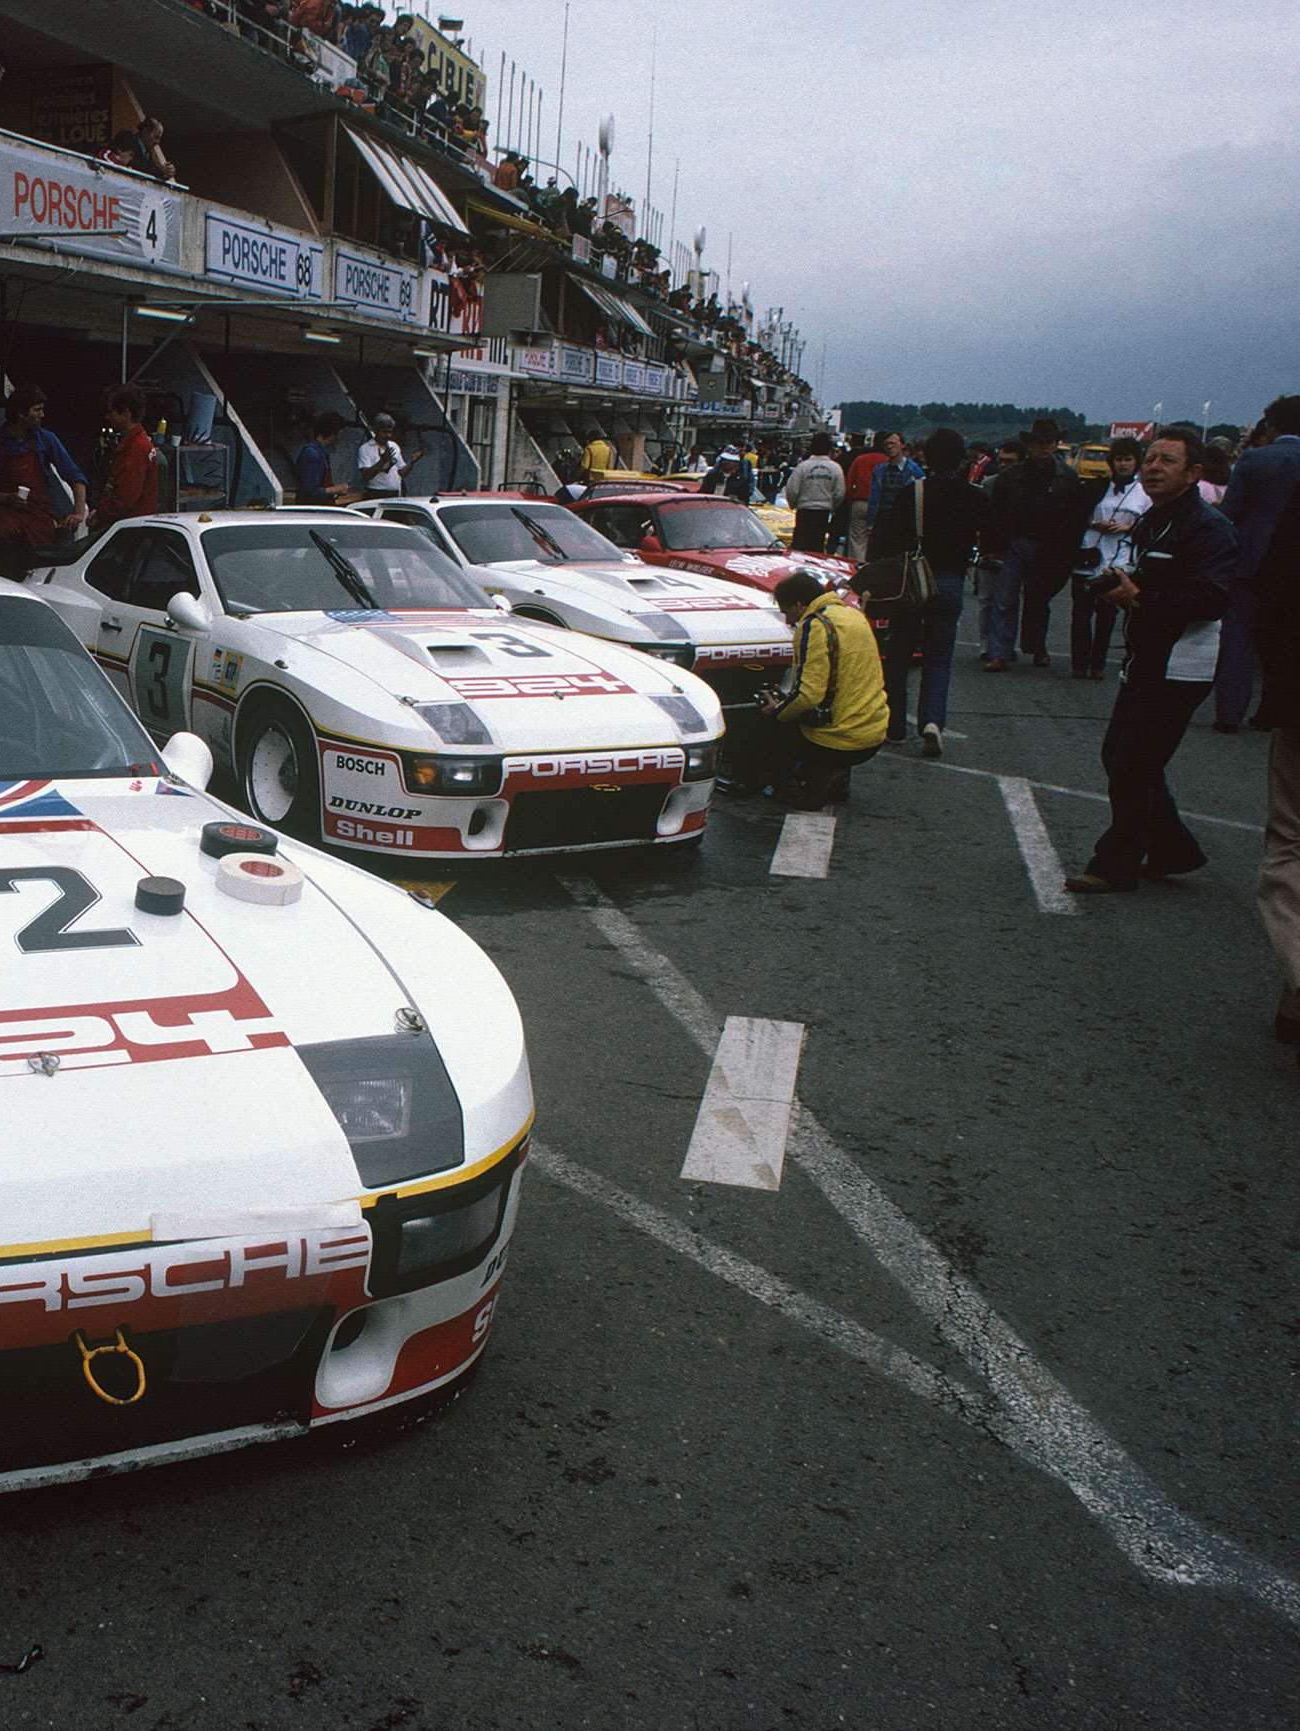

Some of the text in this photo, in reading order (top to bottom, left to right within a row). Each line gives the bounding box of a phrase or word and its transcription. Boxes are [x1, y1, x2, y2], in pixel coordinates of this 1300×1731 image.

[14, 171, 158, 249] PORSCHE 4
[222, 230, 311, 287] PORSCHE 68
[345, 264, 411, 307] PORSCHE 69
[653, 574, 703, 591] 4
[648, 596, 752, 609] 924
[468, 633, 553, 657] 3
[696, 646, 794, 661] PORSCHE
[149, 641, 171, 719] 3
[448, 676, 626, 697] 924
[336, 755, 385, 776] BOSCH
[505, 752, 684, 780] PORSCHE
[328, 795, 423, 820] DUNLOP
[336, 819, 413, 845] Shell
